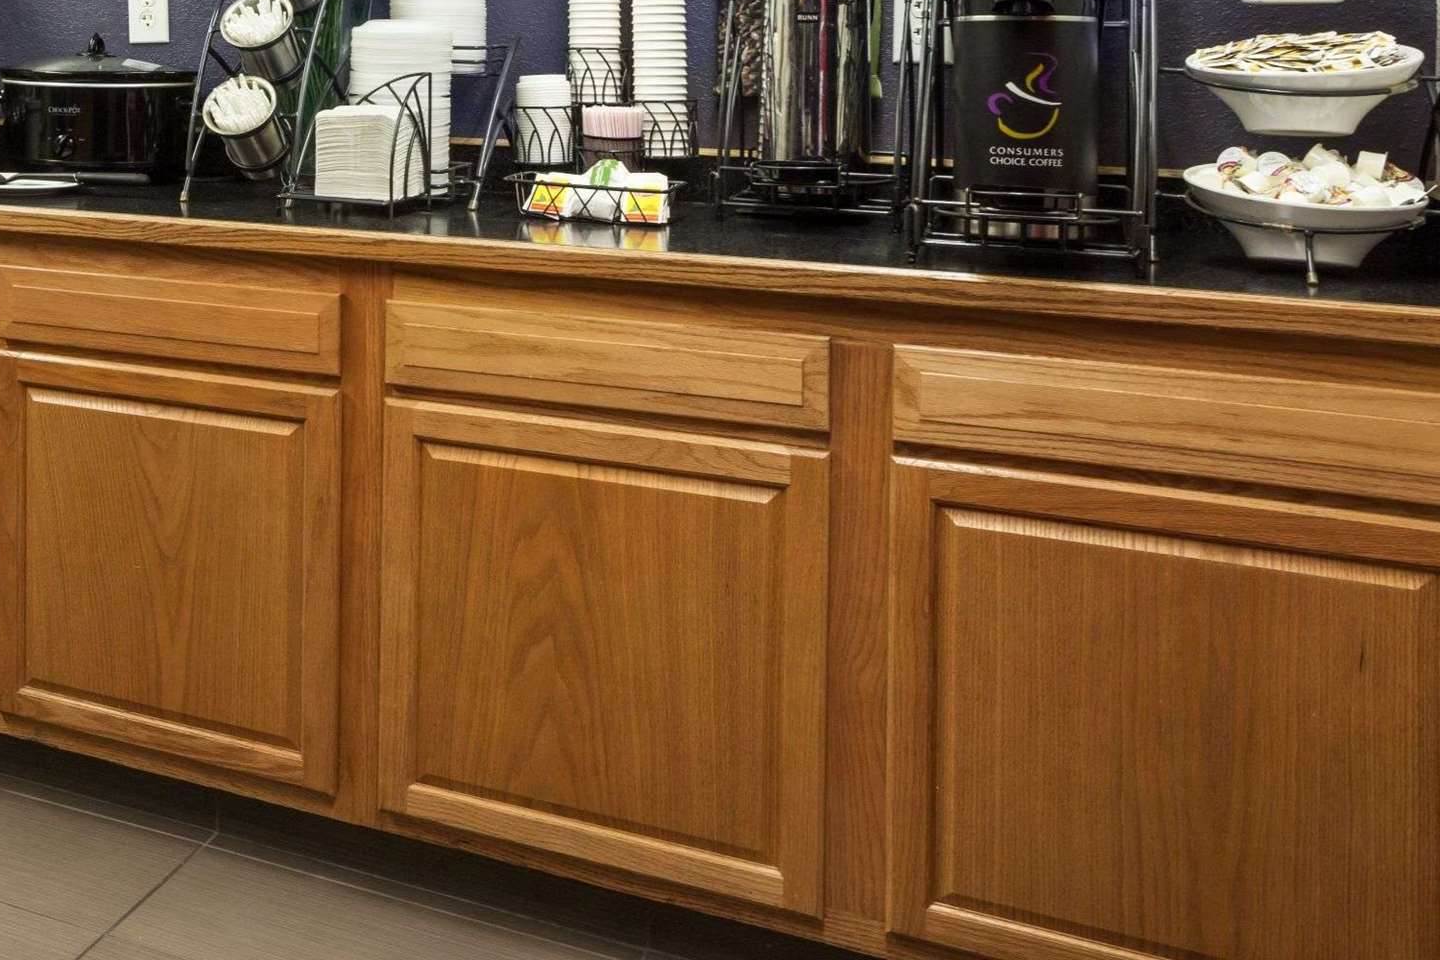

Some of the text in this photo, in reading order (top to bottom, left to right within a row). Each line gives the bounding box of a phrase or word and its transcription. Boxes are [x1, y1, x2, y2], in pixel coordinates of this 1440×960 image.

[797, 13, 818, 21] BUNN
[989, 146, 1064, 157] CONSUMERS
[989, 156, 1063, 167] CHOICE COFFEE
